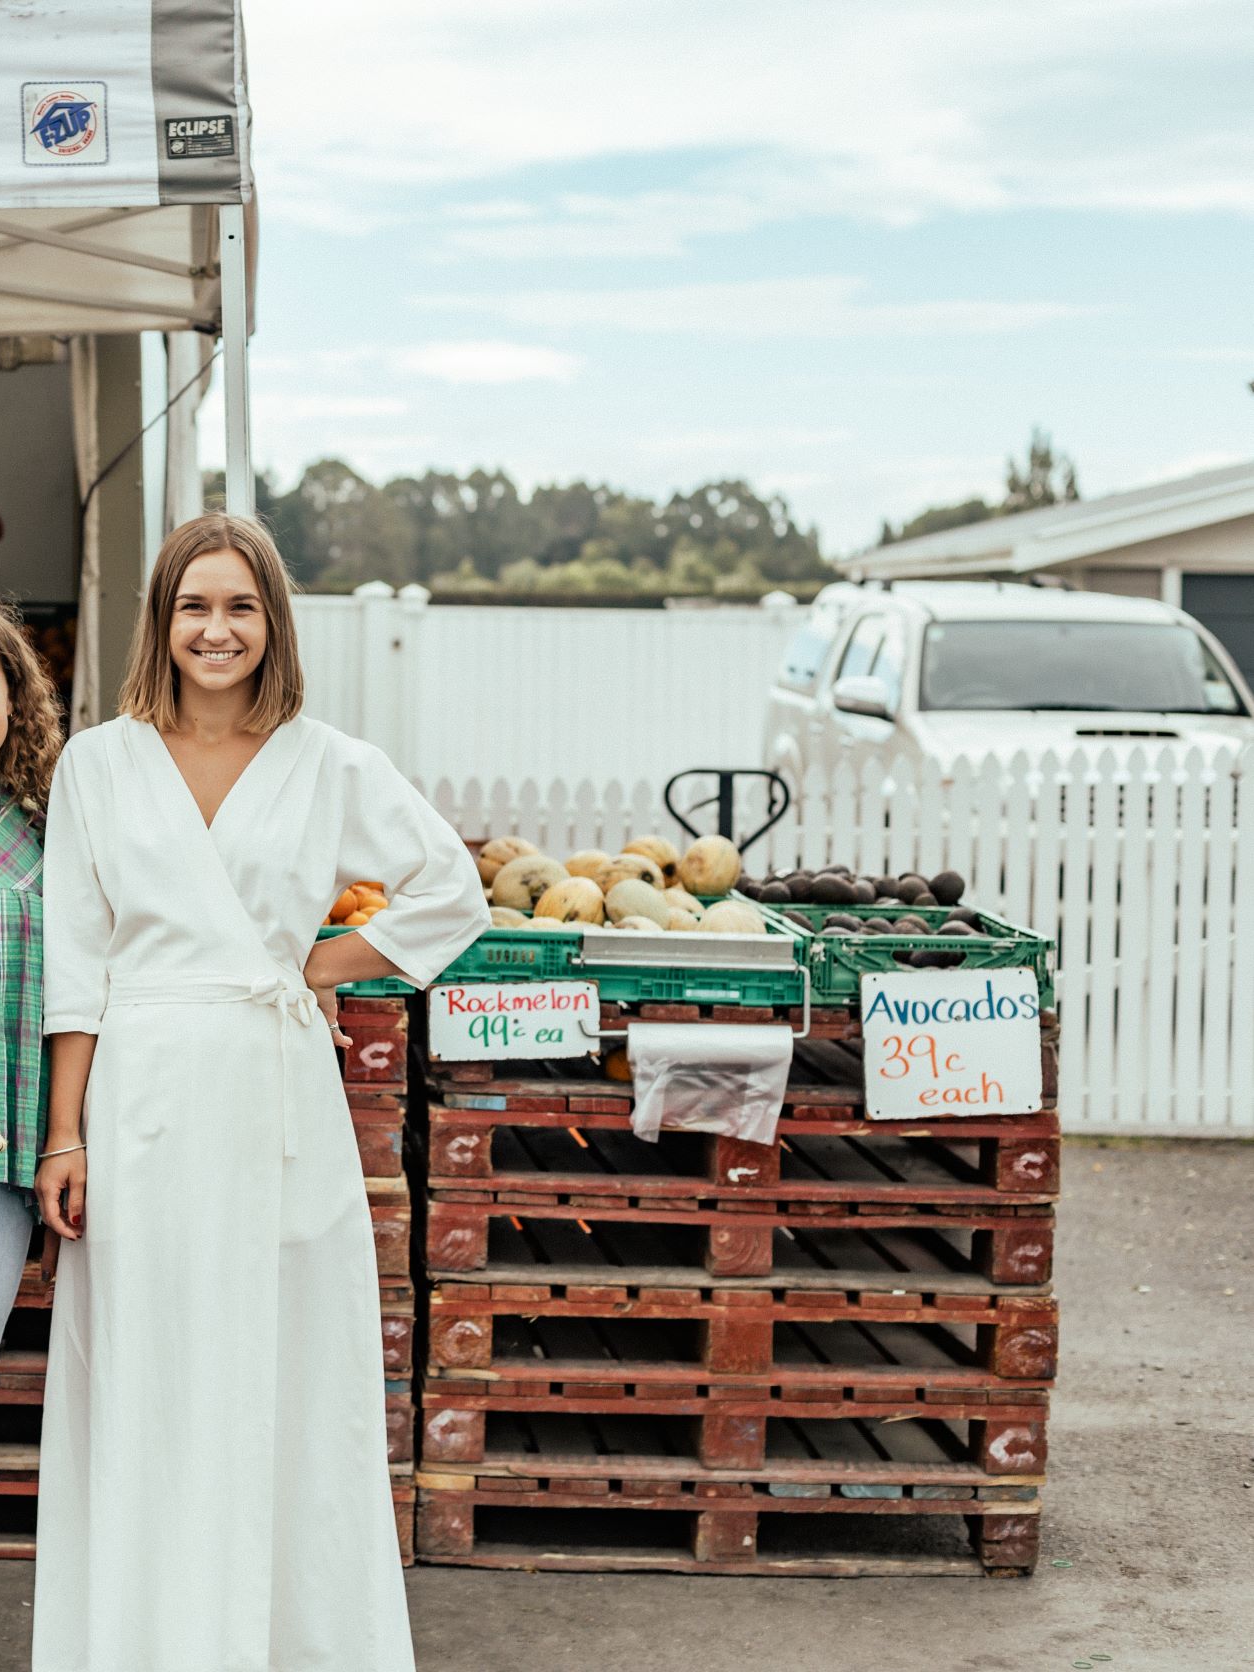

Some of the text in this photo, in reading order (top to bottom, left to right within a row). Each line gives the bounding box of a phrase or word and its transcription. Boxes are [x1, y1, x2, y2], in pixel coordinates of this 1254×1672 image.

[168, 119, 226, 137] ECLIPSE
[448, 988, 589, 1015] Rockmelon
[863, 980, 1040, 1025] Avocados
[535, 1027, 564, 1043] ea
[918, 1072, 1004, 1106] each
